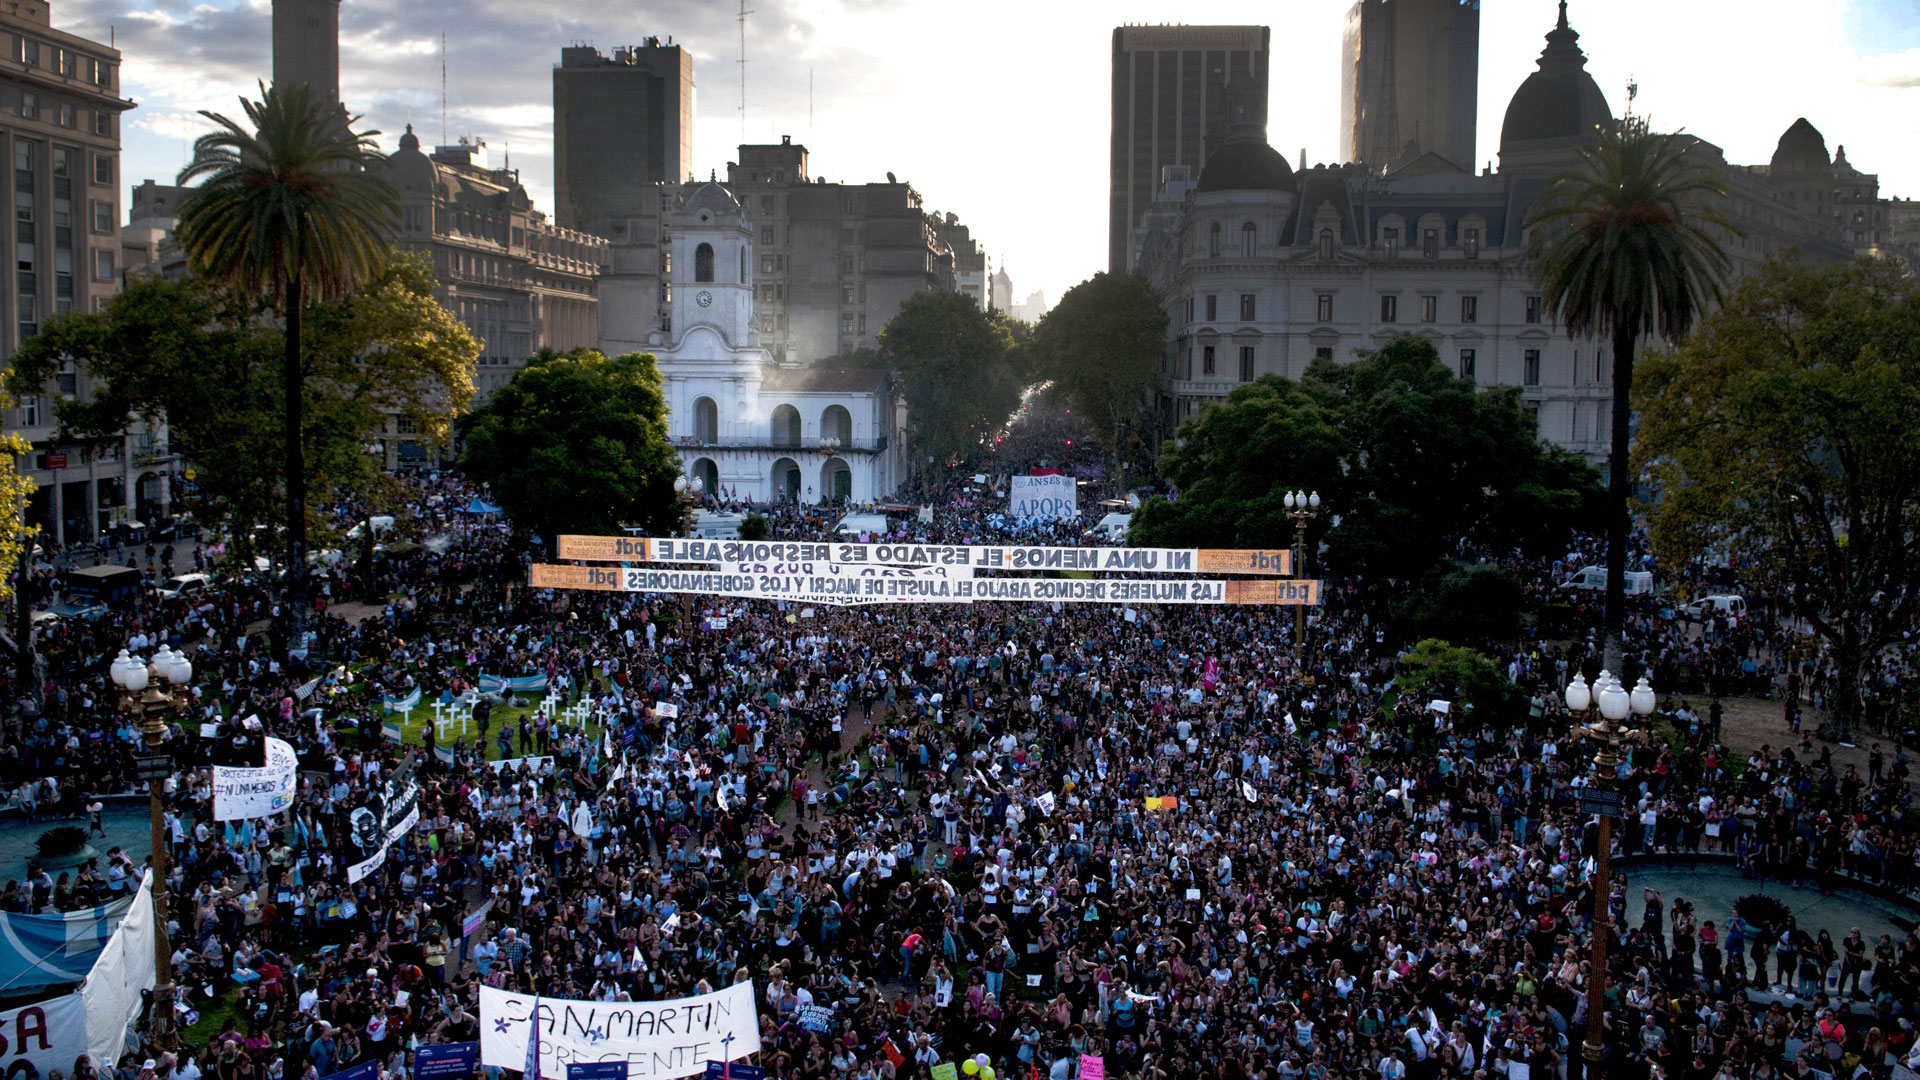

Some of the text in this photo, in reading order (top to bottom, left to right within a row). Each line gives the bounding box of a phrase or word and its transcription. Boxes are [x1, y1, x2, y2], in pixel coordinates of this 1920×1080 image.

[1027, 476, 1061, 487] ANSES
[1017, 498, 1073, 518] APOPS
[505, 996, 732, 1040] SAN MARTIN
